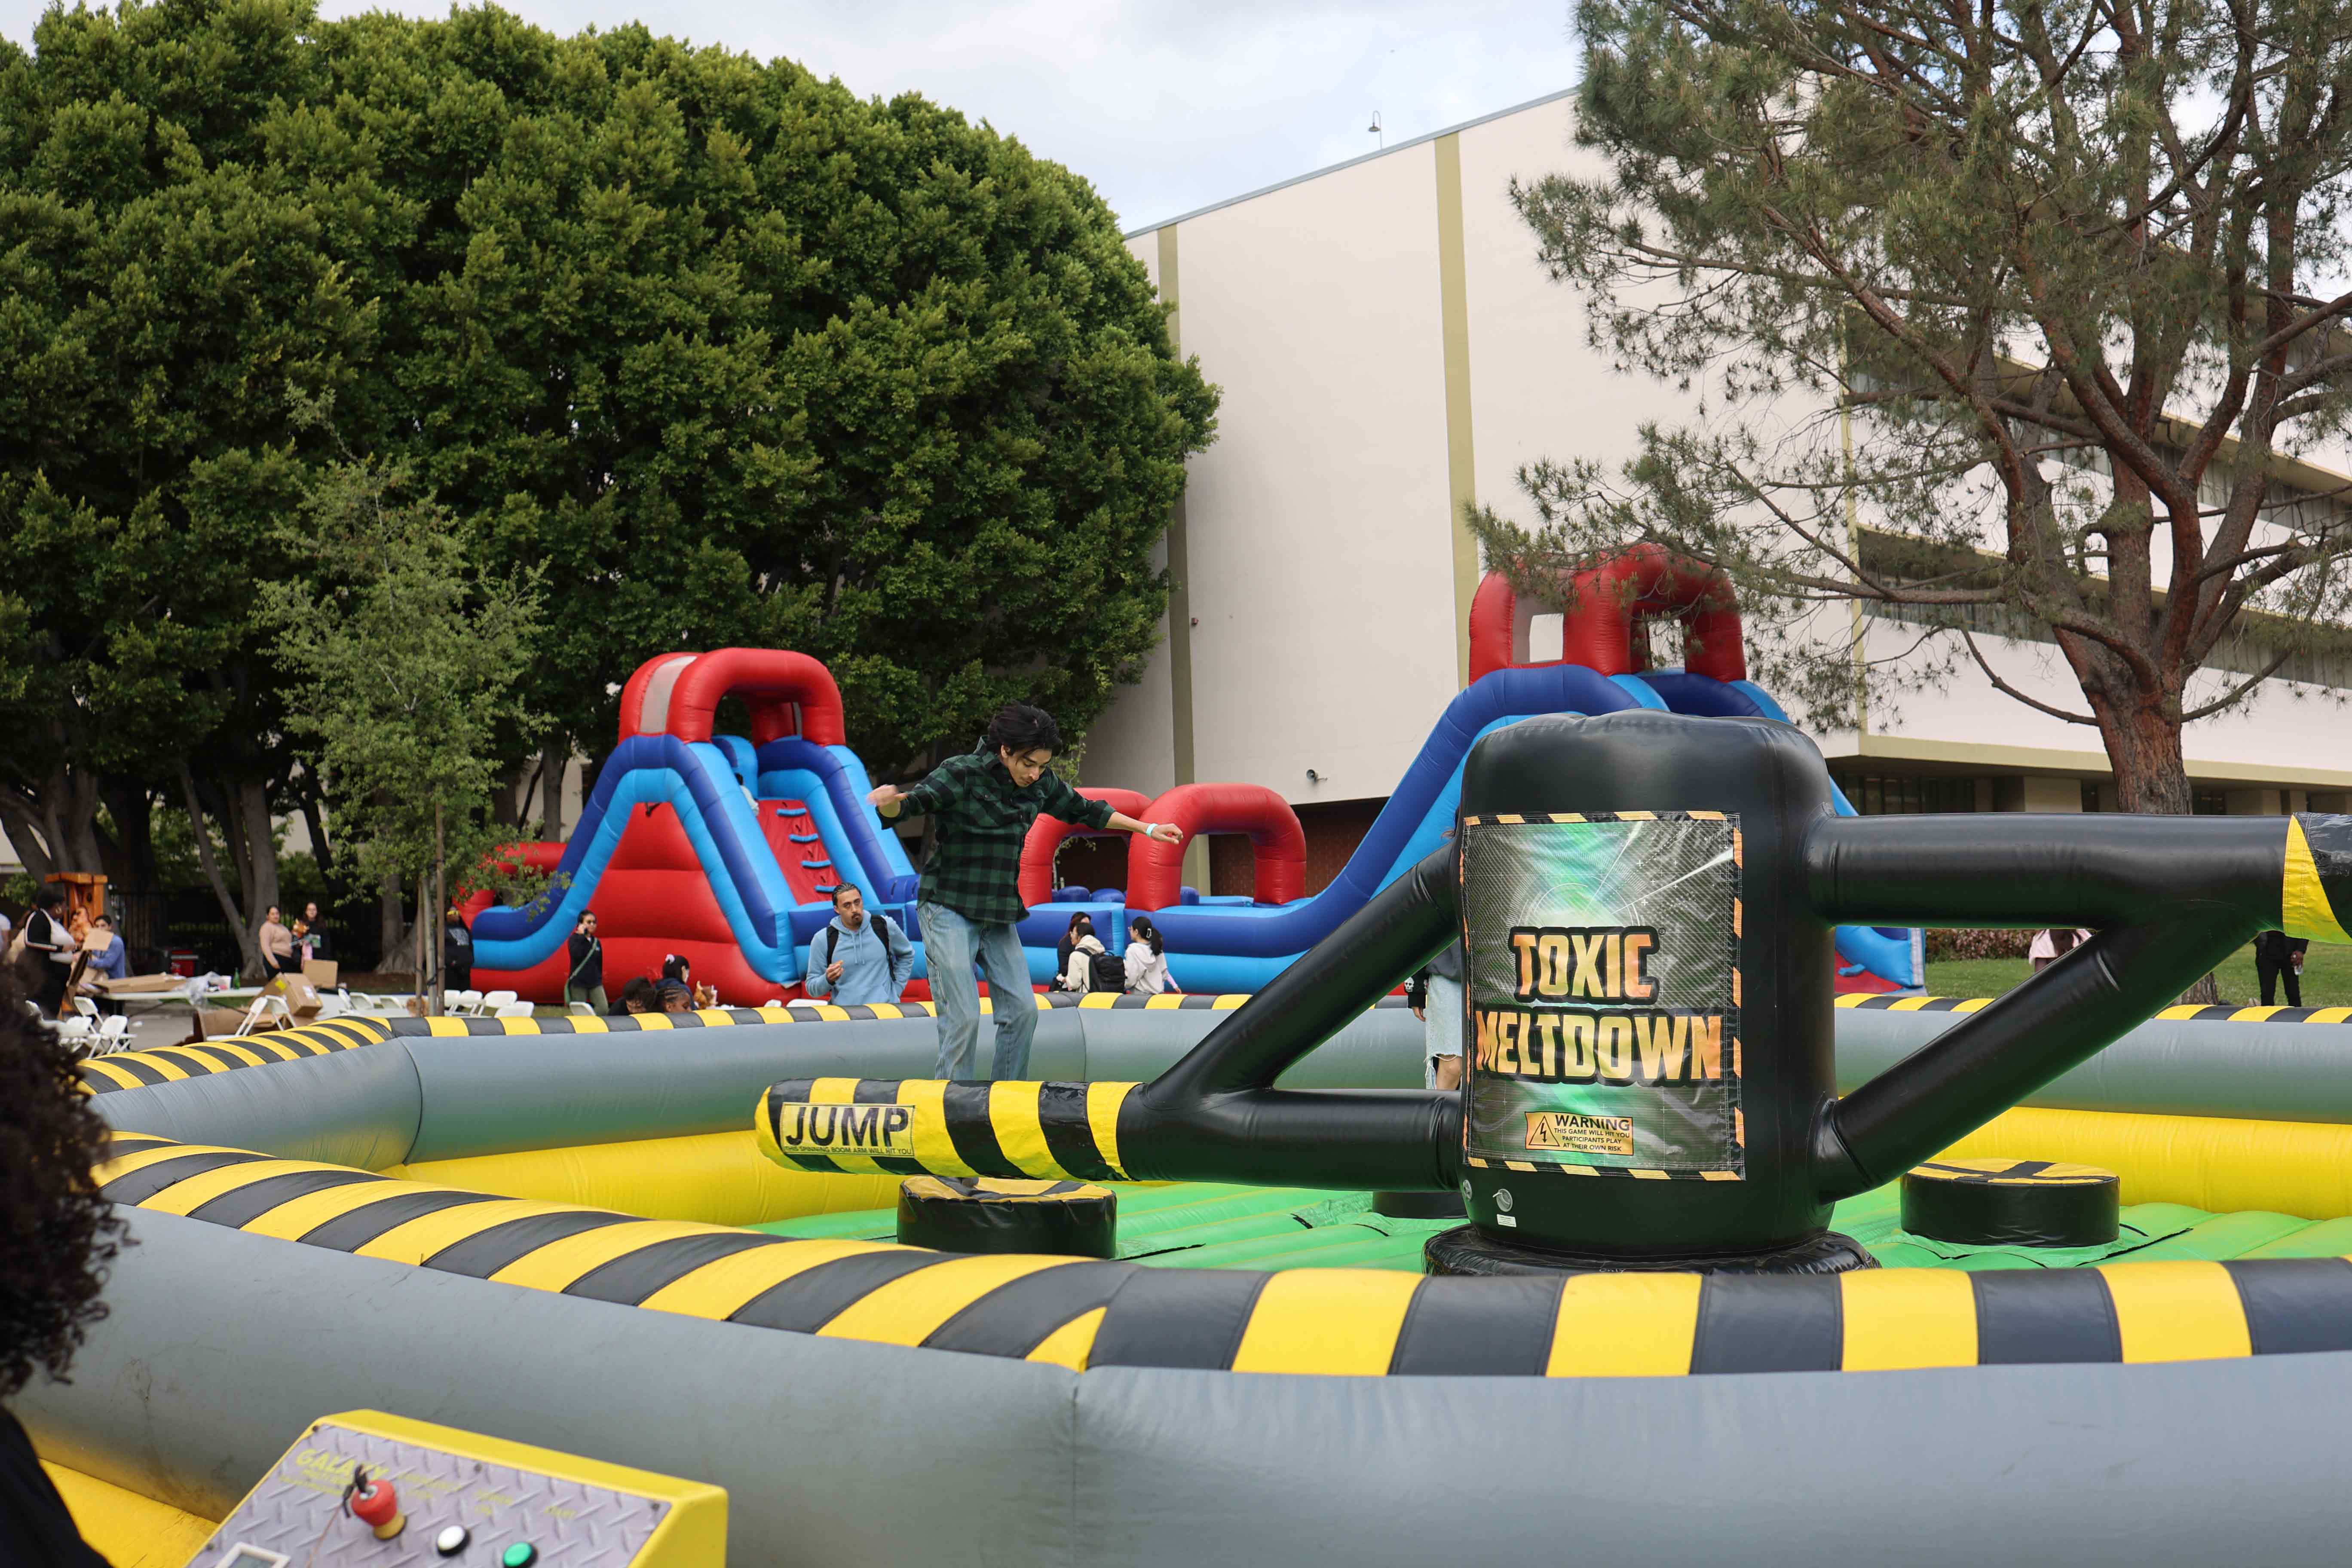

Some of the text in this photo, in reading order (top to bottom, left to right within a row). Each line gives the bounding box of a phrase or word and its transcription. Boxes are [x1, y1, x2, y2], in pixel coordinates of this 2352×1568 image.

[1513, 933, 1653, 998] TOXIC
[1475, 1010, 1722, 1081] MELTDOWN
[785, 1106, 909, 1147] JUMP
[1555, 1114, 1630, 1131] WARNING
[296, 1448, 389, 1481] GALAY
